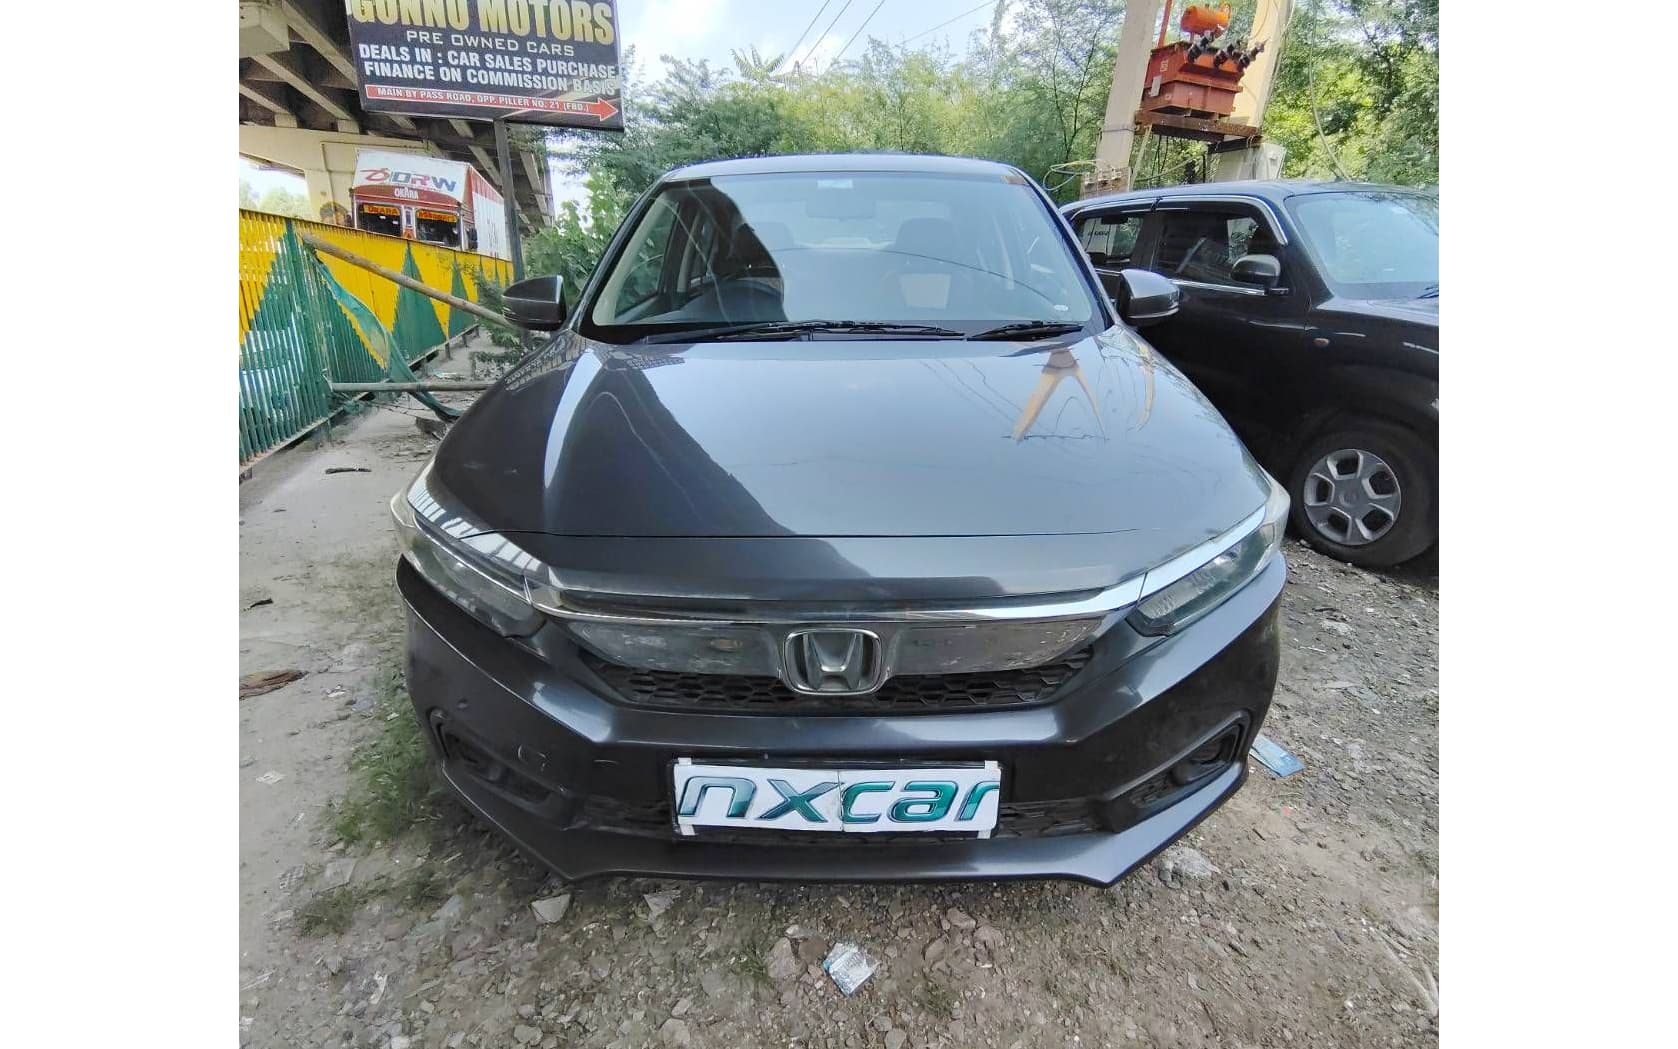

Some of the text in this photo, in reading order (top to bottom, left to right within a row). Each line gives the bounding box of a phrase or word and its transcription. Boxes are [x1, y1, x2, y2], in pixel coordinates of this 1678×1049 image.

[478, 0, 616, 45] MOTORS
[359, 43, 411, 61] DEALS
[415, 47, 432, 63] IN
[448, 50, 480, 67] CAR
[485, 54, 532, 72] SALES
[537, 58, 615, 79] PURCHASE
[406, 30, 575, 57] PRE OWNED CARS
[364, 61, 616, 96] FINANCE ON COMMISSION BASIS
[378, 87, 402, 97] MAIN
[406, 89, 417, 98] BY
[420, 90, 444, 100] PASS
[499, 96, 530, 108] PILLER
[550, 100, 560, 109] 21
[679, 775, 1001, 824] nxcar
